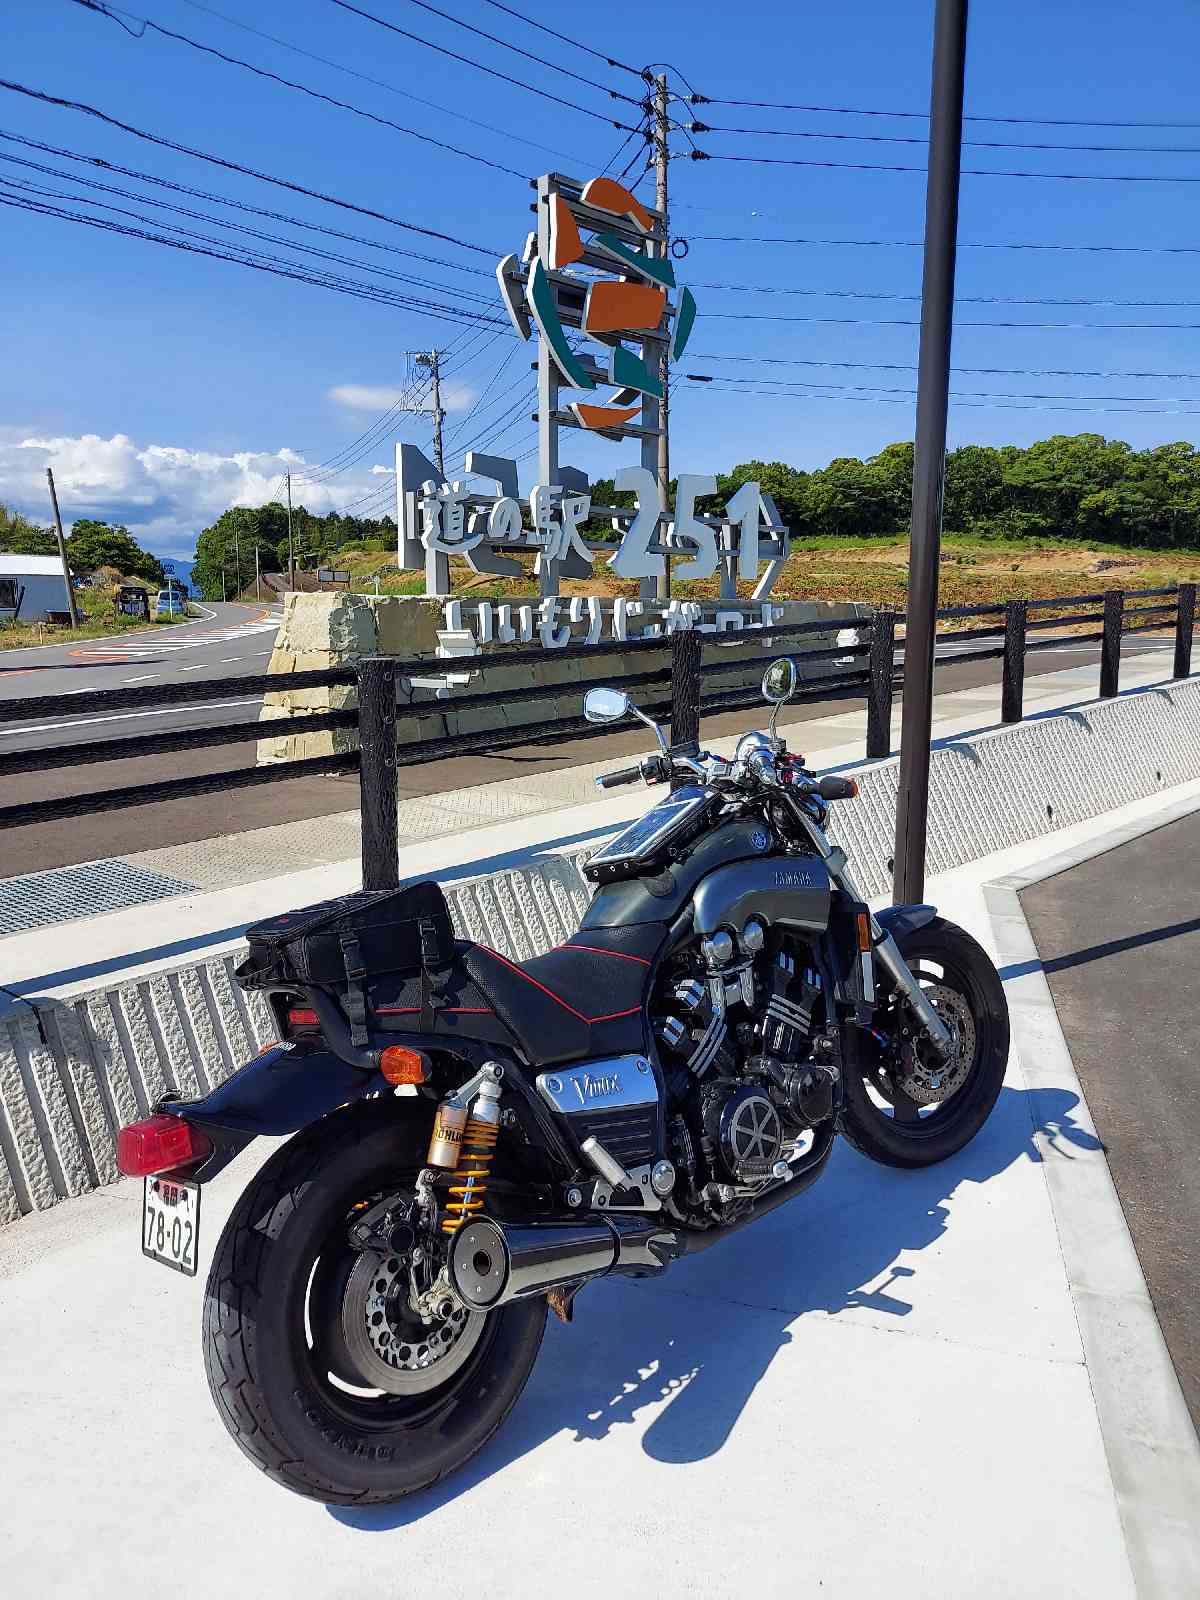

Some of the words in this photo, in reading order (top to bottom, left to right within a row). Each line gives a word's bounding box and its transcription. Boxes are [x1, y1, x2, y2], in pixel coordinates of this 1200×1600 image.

[419, 479, 595, 563] 道の駅
[607, 465, 761, 580] 251
[774, 871, 812, 886] YAMAHA
[147, 1205, 193, 1265] 78-02
